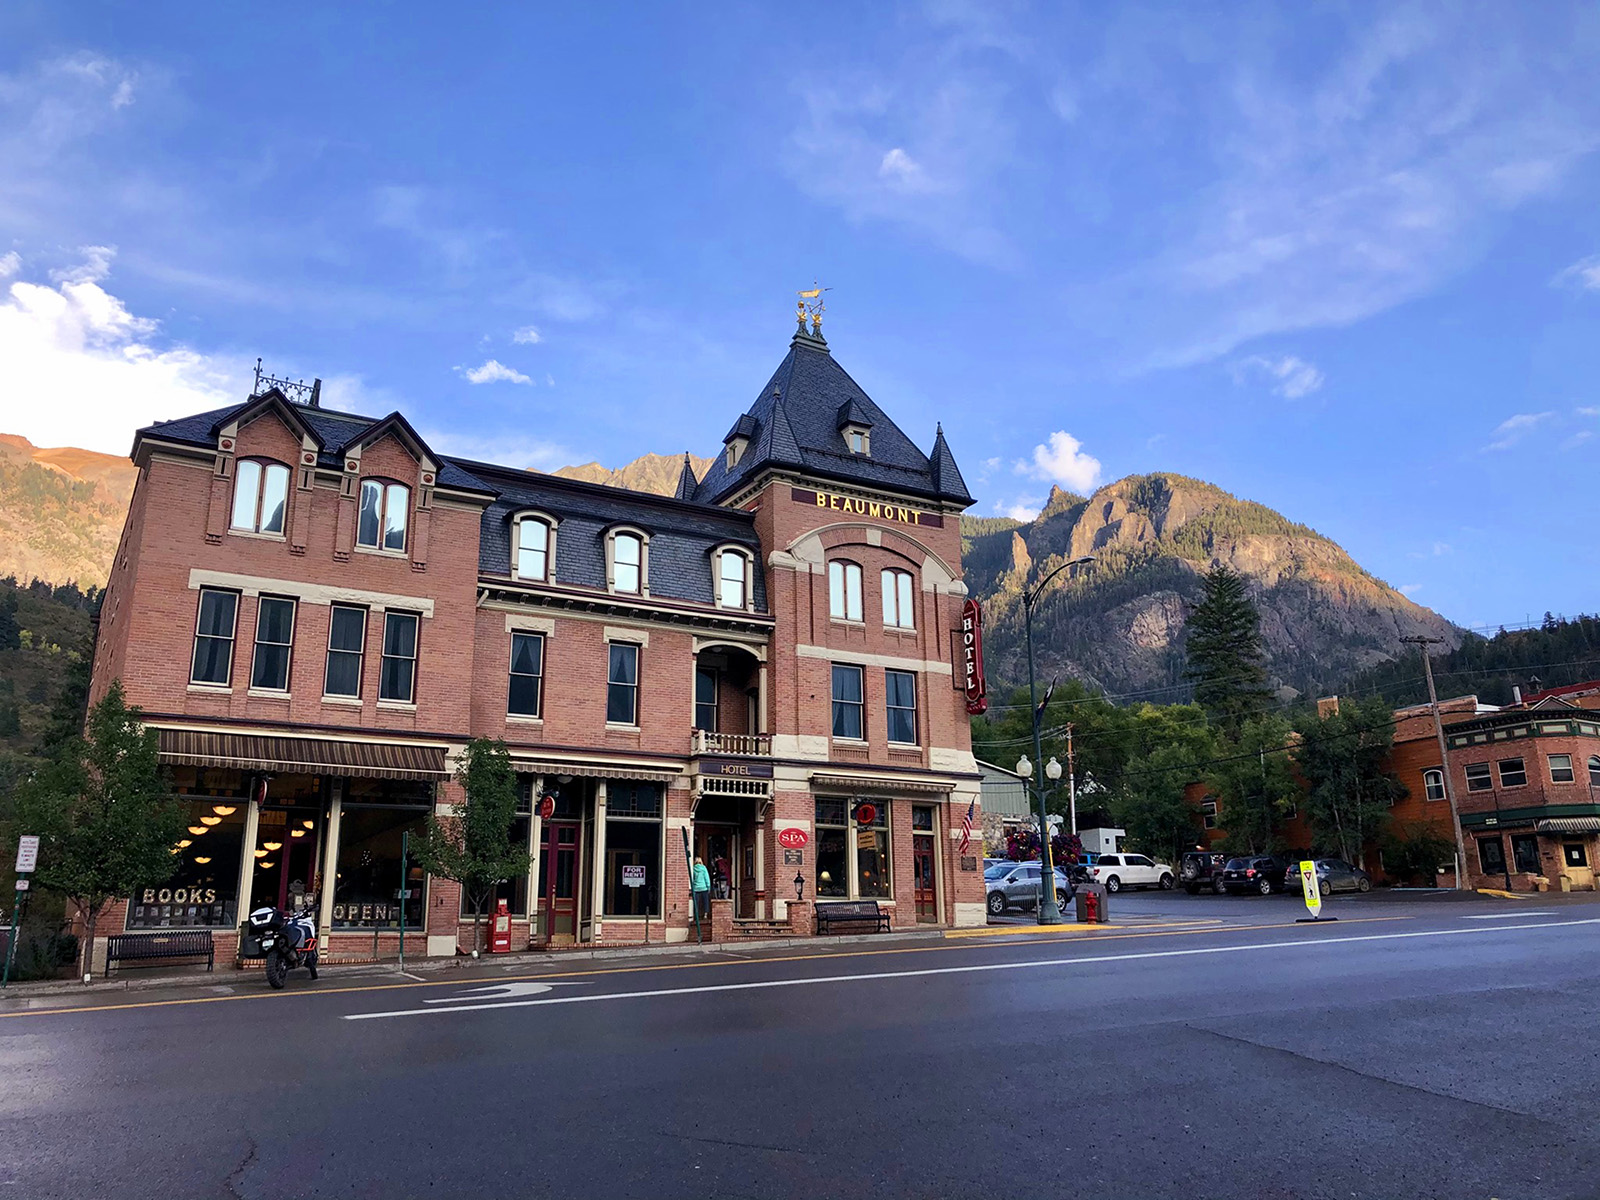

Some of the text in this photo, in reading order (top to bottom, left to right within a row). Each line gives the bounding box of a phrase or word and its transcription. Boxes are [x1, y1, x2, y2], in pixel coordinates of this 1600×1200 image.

[816, 492, 921, 525] BEAUMONT
[963, 618, 975, 690] HOTEL
[721, 765, 751, 775] HOTEL
[781, 833, 805, 842] SPA
[143, 888, 216, 904] BOOKS
[333, 905, 386, 920] OPEN
